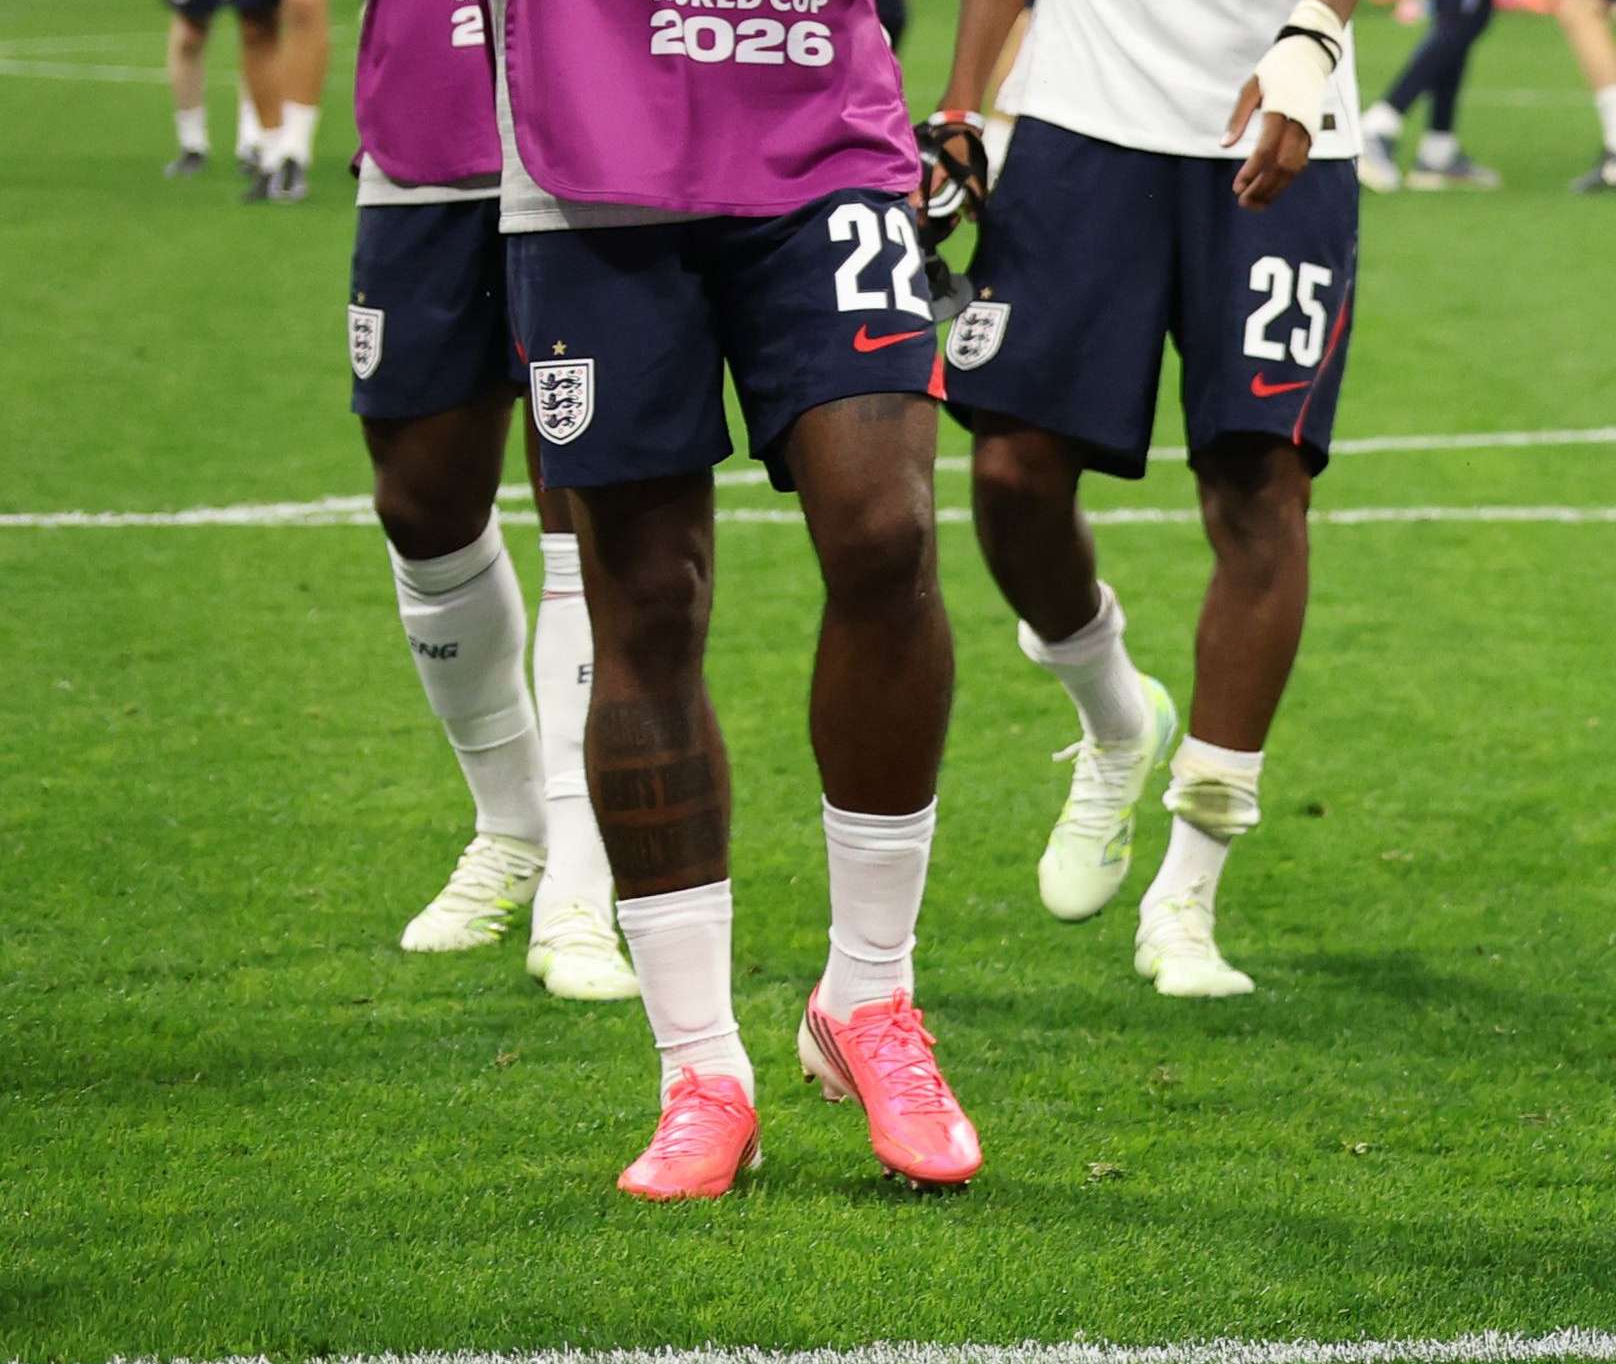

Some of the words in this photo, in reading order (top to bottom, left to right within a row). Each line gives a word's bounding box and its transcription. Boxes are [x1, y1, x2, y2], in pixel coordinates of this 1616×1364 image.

[650, 8, 835, 67] 2026
[828, 202, 934, 322] 22
[1243, 255, 1333, 368] 25
